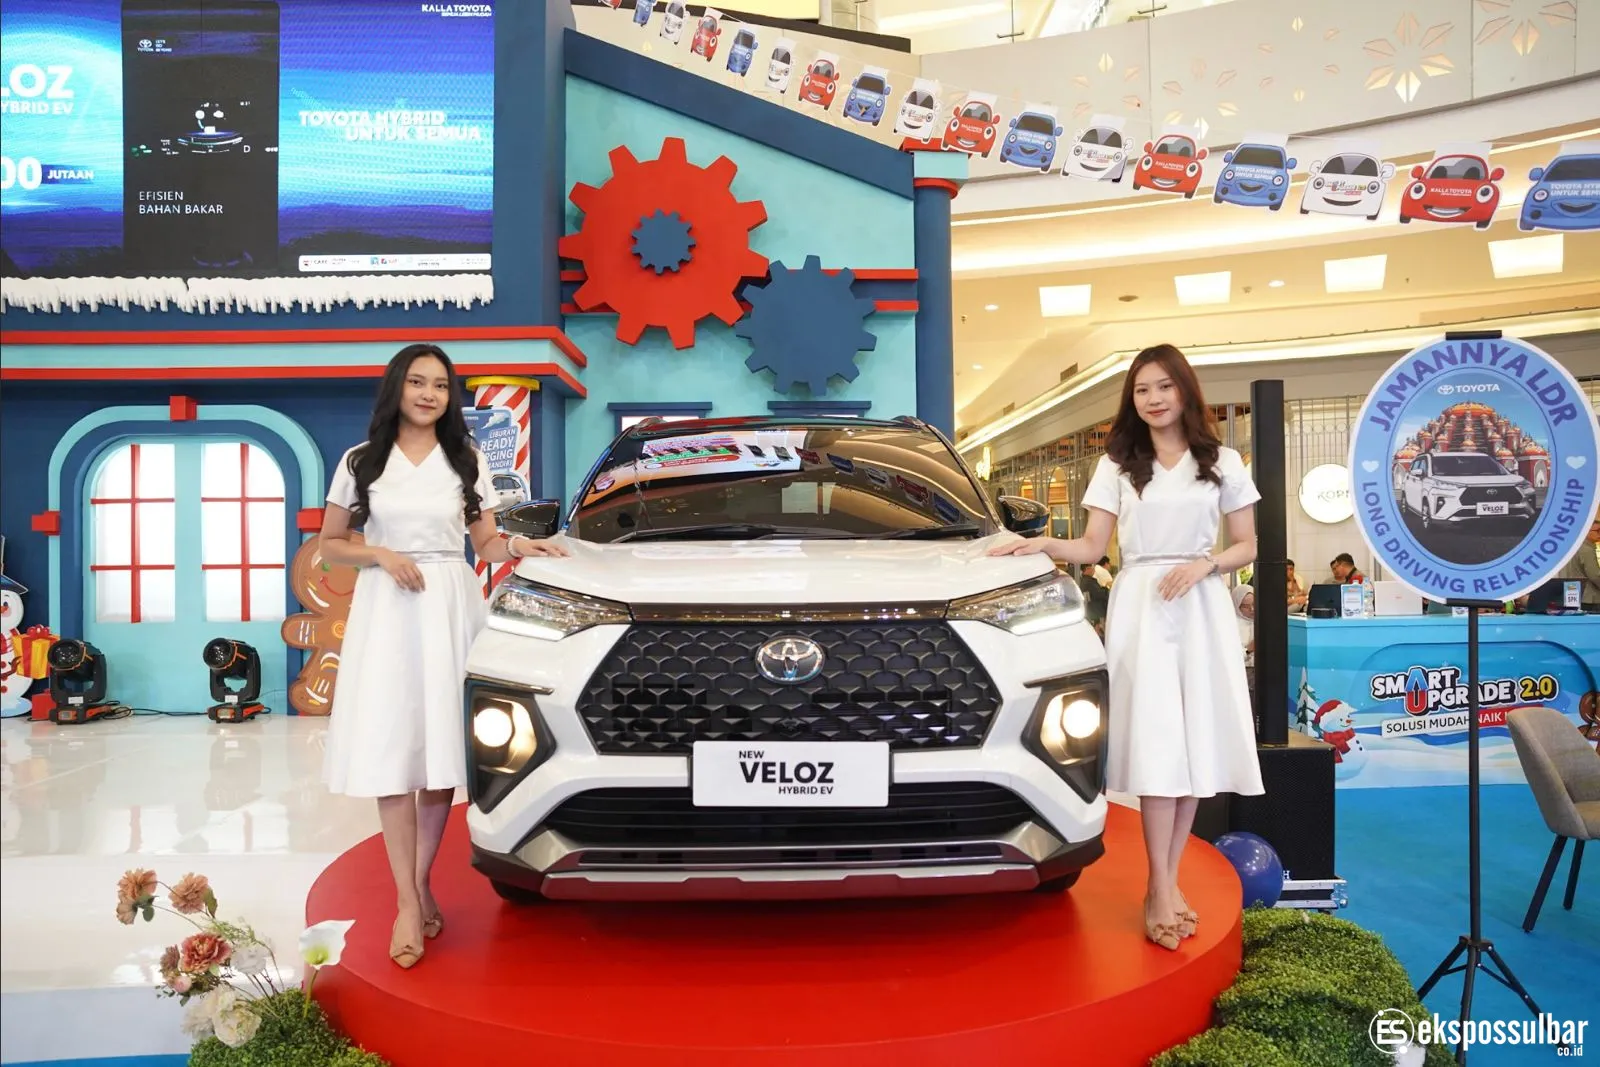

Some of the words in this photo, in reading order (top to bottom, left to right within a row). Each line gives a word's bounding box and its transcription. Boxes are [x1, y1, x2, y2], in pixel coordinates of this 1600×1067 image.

[421, 4, 453, 12] KALLA
[453, 4, 492, 12] TOYOTA
[52, 101, 74, 115] EV
[299, 110, 371, 126] TOYOTA
[375, 111, 446, 126] HYBRID
[346, 126, 411, 141] UNTUK
[414, 126, 482, 140] SEMUA
[48, 169, 94, 179] JUTAAN
[139, 191, 184, 200] EFISIEN
[139, 205, 181, 214] BAHAN
[185, 205, 224, 214] BAKAR
[1370, 342, 1529, 432] JAMANNYA
[1525, 368, 1578, 427] LDR
[1456, 384, 1500, 393] TOYOTA
[489, 429, 516, 438] LIBURAN
[1362, 481, 1391, 537] LONG
[1384, 538, 1465, 593] DRIVING
[1474, 478, 1585, 593] RELATIONSHIP
[1373, 667, 1456, 696] SMART
[1520, 677, 1554, 698] 2.0
[1386, 719, 1426, 733] SOLUSI
[1429, 714, 1469, 729] MUDAH
[739, 750, 765, 759] NEW
[739, 762, 834, 784] VELOZ
[778, 786, 818, 795] HYBRID
[820, 786, 834, 795] EV
